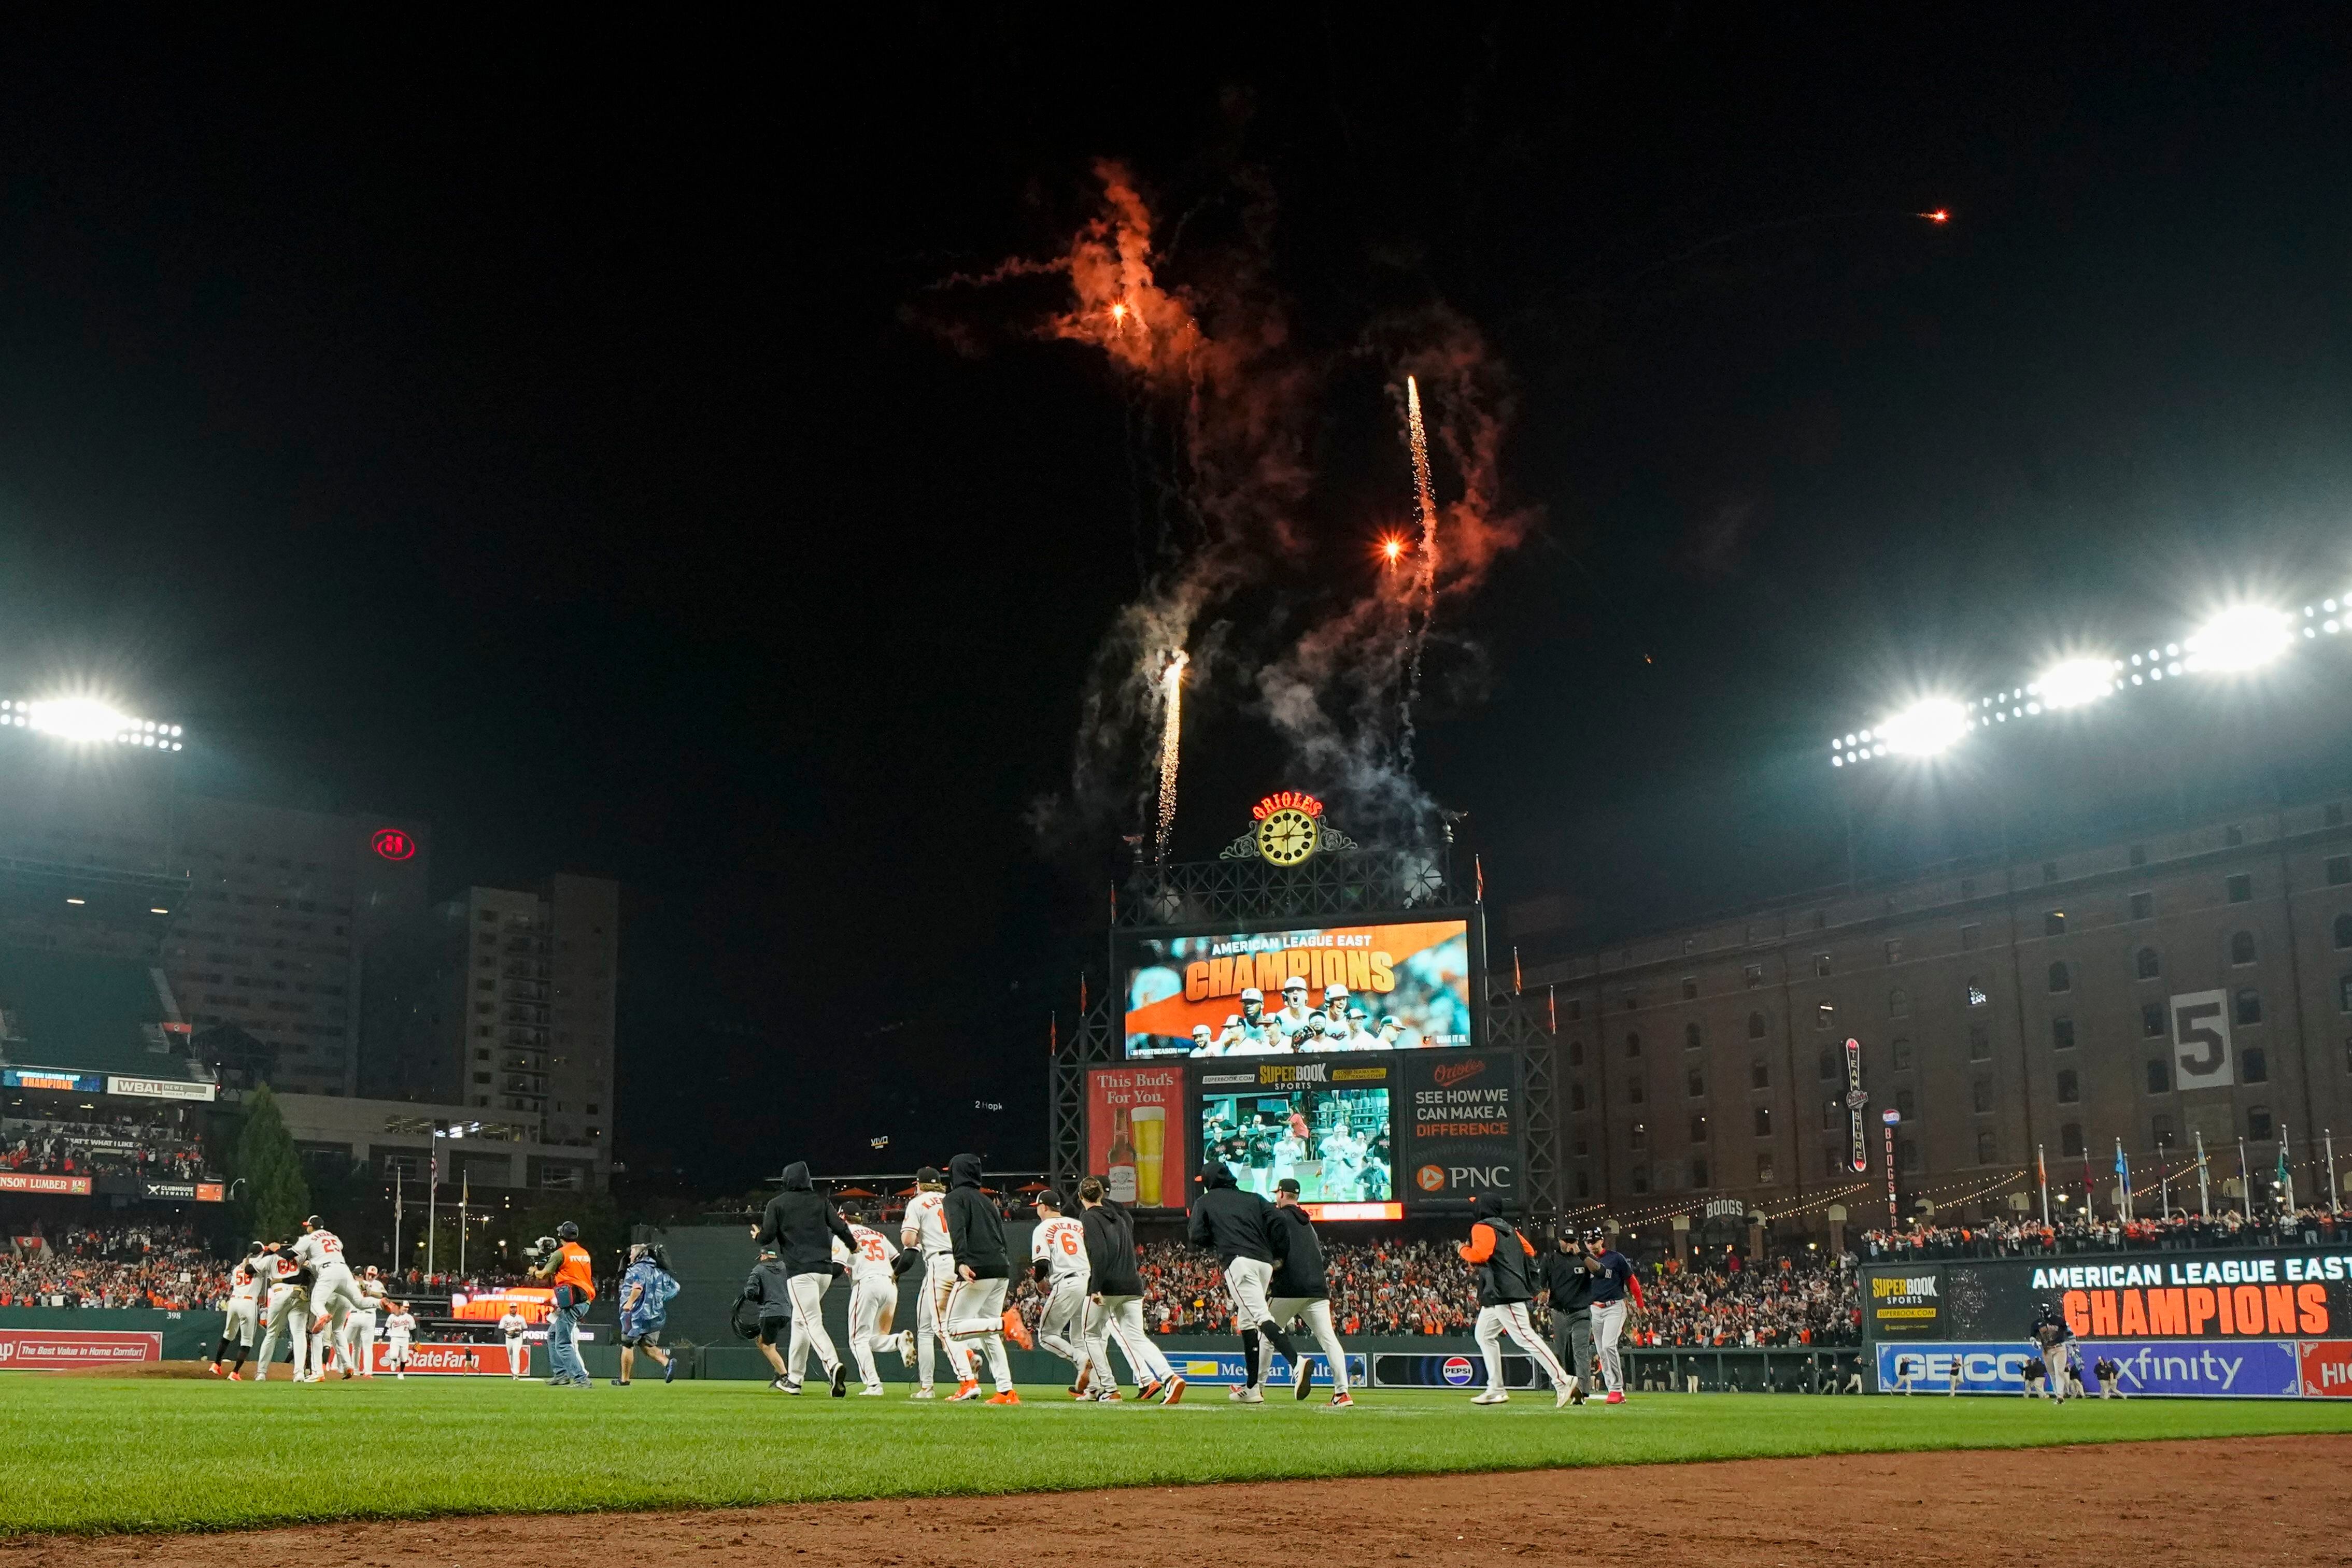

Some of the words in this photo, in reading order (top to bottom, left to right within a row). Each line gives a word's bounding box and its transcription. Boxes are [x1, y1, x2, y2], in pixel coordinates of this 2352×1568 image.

[1252, 791, 1323, 819] ORIOLES
[1212, 937, 1280, 956] AMERICAN
[1283, 936, 1333, 948] LEAGUE
[1337, 935, 1372, 947] EAST
[1185, 949, 1395, 1001] CHAMPIONS
[2176, 1001, 2225, 1076] 5
[1259, 1063, 1327, 1085] SUPERBOOK
[1434, 1059, 1485, 1086] Orioles
[1850, 1050, 1858, 1088] TEAM
[23, 1077, 73, 1090] CHAMPIONS
[119, 1081, 162, 1093] WBAL
[1097, 1074, 1131, 1088] This
[1136, 1073, 1173, 1087] Bud's
[975, 1100, 980, 1108] 2
[1107, 1091, 1131, 1104] For
[1135, 1090, 1165, 1103] You.
[1415, 1091, 1443, 1104] SEE
[1447, 1089, 1481, 1103] HOW
[1484, 1089, 1509, 1102] WE
[1417, 1107, 1447, 1120] CAN
[1451, 1106, 1494, 1119] MAKE
[1497, 1105, 1508, 1118] A
[1416, 1122, 1509, 1137] DIFFERENCE
[1854, 1112, 1863, 1159] STORE
[30, 1179, 67, 1190] LUMBER
[1449, 1166, 1511, 1188] PNC
[1706, 1199, 1743, 1219] BOOG'S
[321, 1239, 341, 1253] 25
[861, 1239, 885, 1261] 35
[1061, 1233, 1078, 1255] 6
[2032, 1264, 2162, 1289] AMERICAN
[2170, 1259, 2277, 1285] LEAGUE
[1872, 1275, 1937, 1298] SUPERBOOK
[1887, 1296, 1922, 1304] SPORTS
[2063, 1284, 2329, 1337] CHAMPIONS
[22, 1346, 36, 1355] The
[37, 1346, 55, 1356] Best
[57, 1347, 78, 1356] Value
[89, 1347, 111, 1356] Home
[112, 1347, 144, 1357] Comfort
[1894, 1353, 2030, 1382] GEICO
[2112, 1347, 2243, 1390] xfinity
